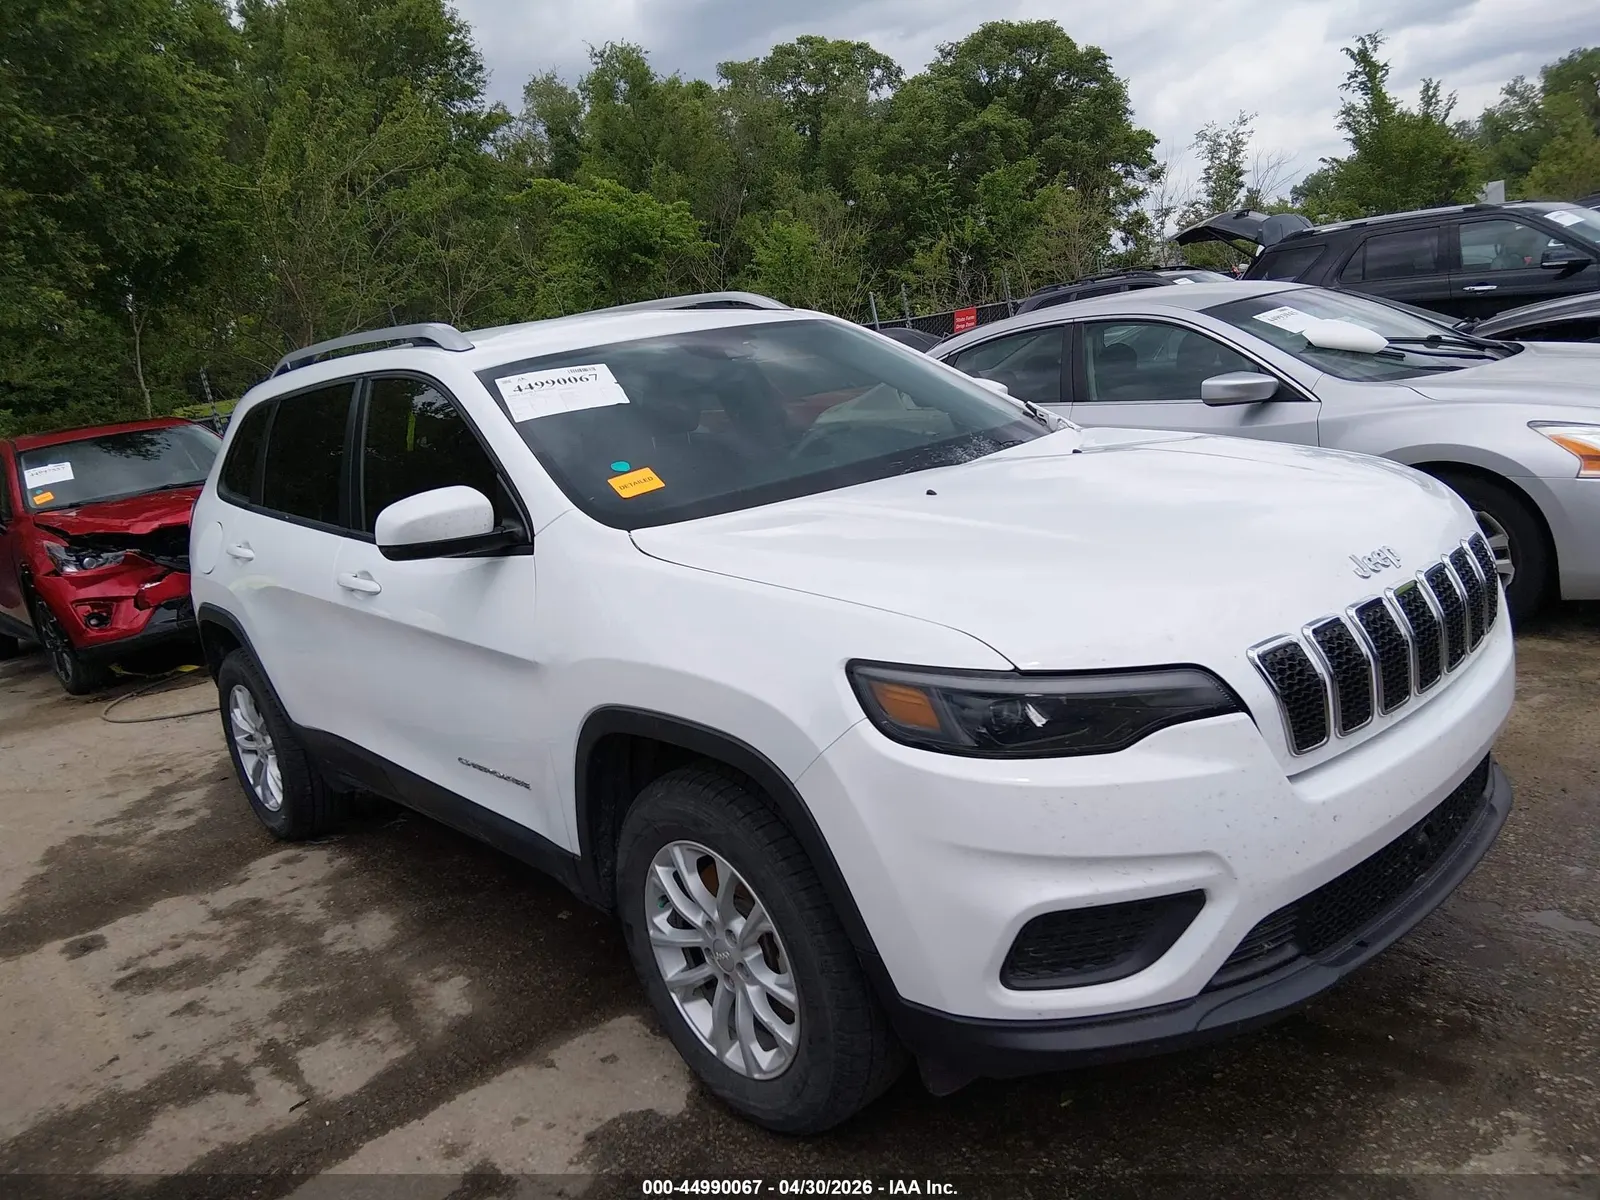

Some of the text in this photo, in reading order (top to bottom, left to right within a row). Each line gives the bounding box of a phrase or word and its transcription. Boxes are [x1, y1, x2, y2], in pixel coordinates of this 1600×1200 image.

[513, 373, 598, 393] 44990067
[618, 476, 654, 491] DETAILED
[1348, 545, 1402, 580] Jeep
